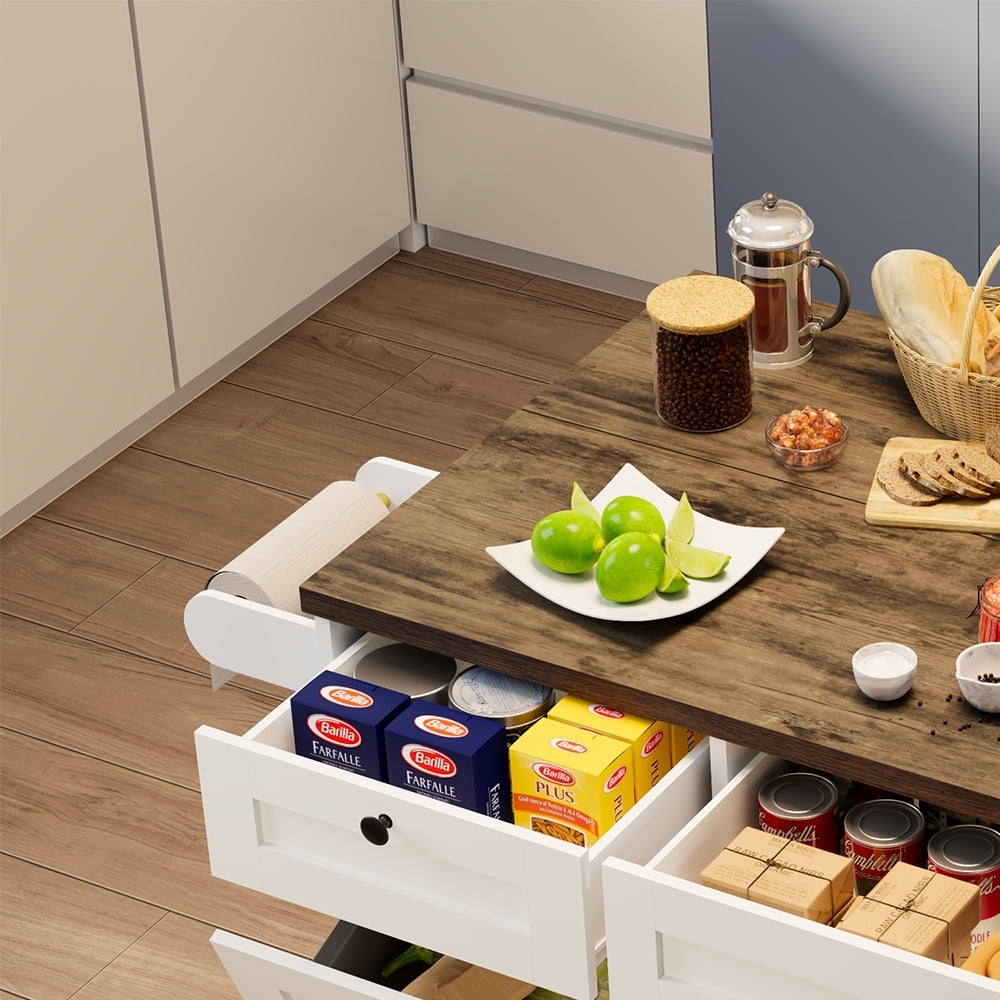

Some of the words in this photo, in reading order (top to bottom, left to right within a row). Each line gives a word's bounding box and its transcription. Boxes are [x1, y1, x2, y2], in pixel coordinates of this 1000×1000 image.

[331, 690, 369, 705] Barilla
[321, 721, 355, 741] Barilla
[425, 719, 466, 735] Barilla
[312, 740, 361, 767] FARFALLE
[415, 751, 450, 771] Barilla
[406, 770, 456, 798] FARFALLE
[543, 767, 571, 782] Barilla
[536, 781, 575, 804] PLUS
[759, 812, 817, 842] Campbell's
